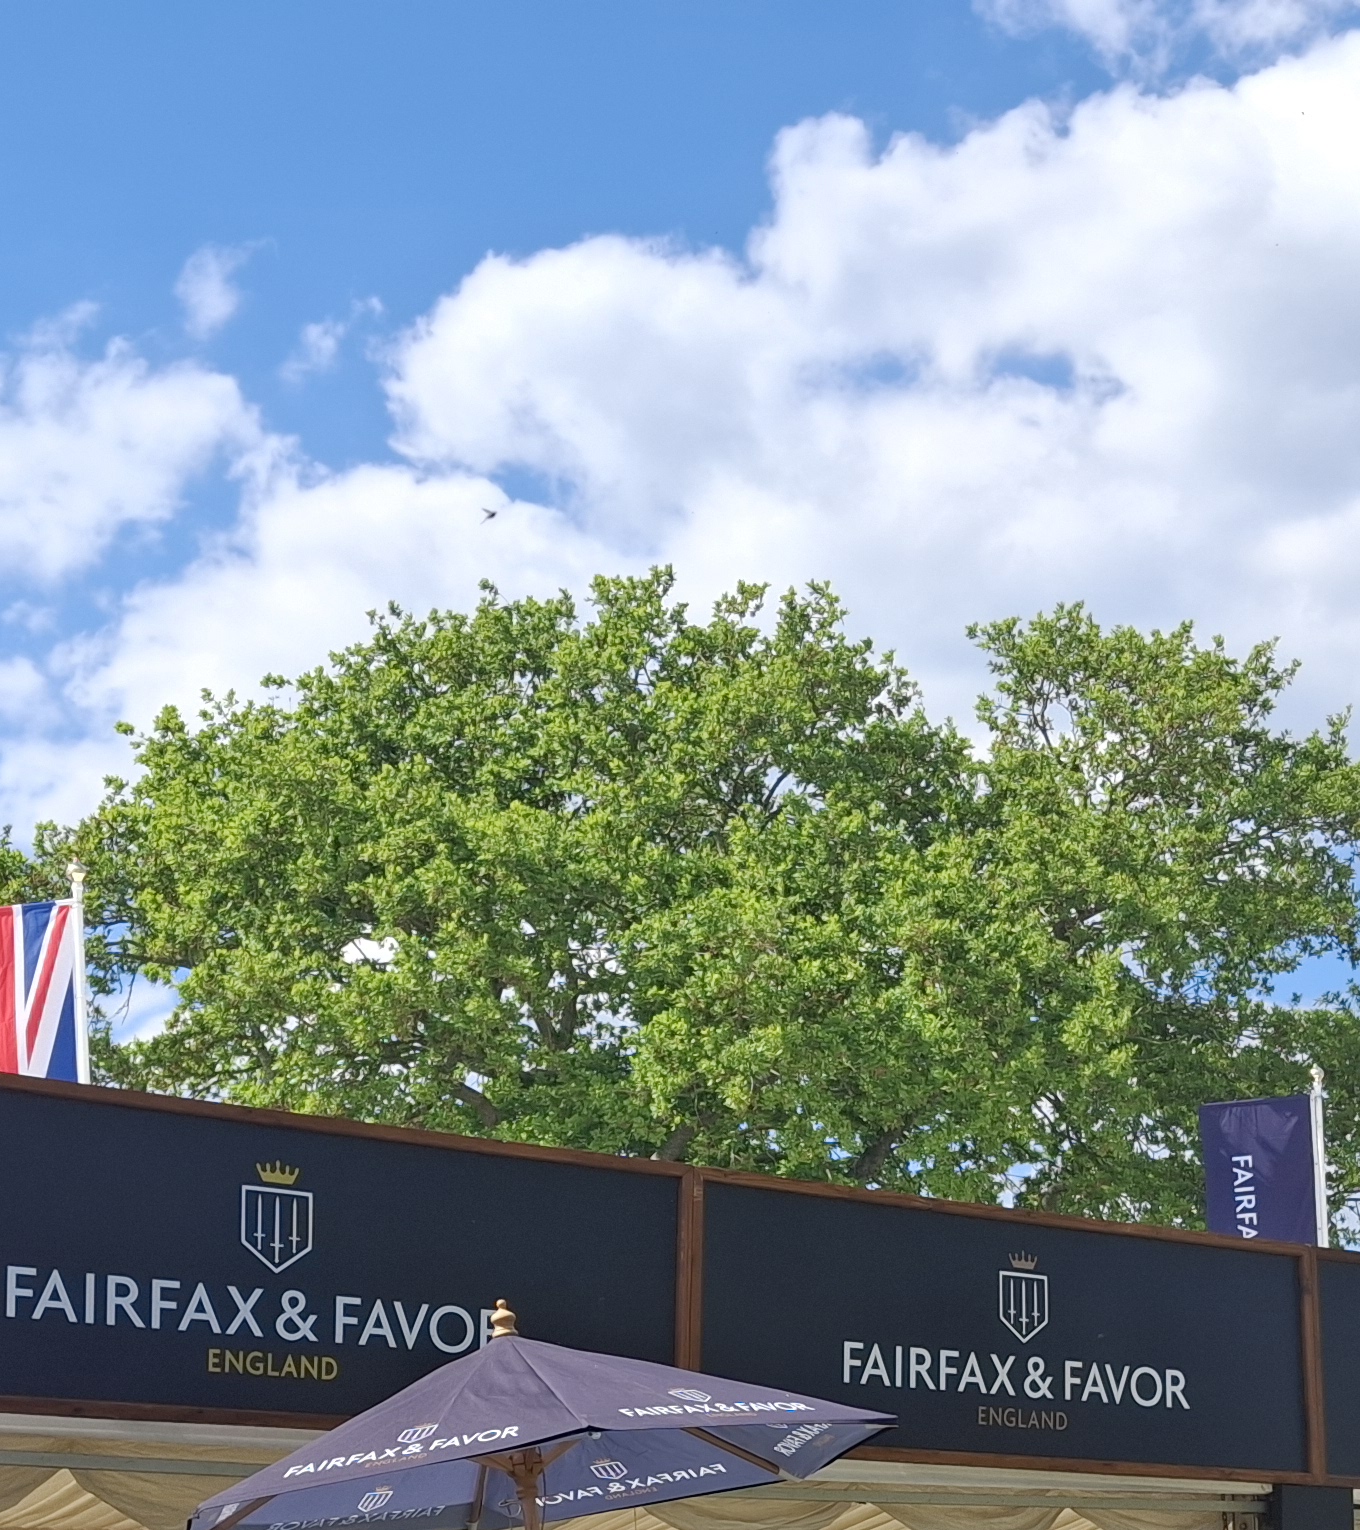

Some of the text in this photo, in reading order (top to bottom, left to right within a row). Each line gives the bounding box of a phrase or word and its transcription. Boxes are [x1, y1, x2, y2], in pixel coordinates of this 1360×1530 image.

[1231, 1155, 1259, 1239] FAIRFA
[5, 1265, 264, 1338] FAIRFAX
[276, 1290, 319, 1342] &
[207, 1348, 339, 1381] ENGLAND
[842, 1340, 1191, 1410] FAIRFAX & FAVOR
[618, 1401, 719, 1417] FAIRFAX
[715, 1402, 740, 1412] &
[734, 1401, 815, 1411] FAVOR
[978, 1406, 1068, 1431] ENGLAND
[283, 1425, 520, 1479] FAIRFAX & FAVOR
[364, 1452, 428, 1469] ENGLAND
